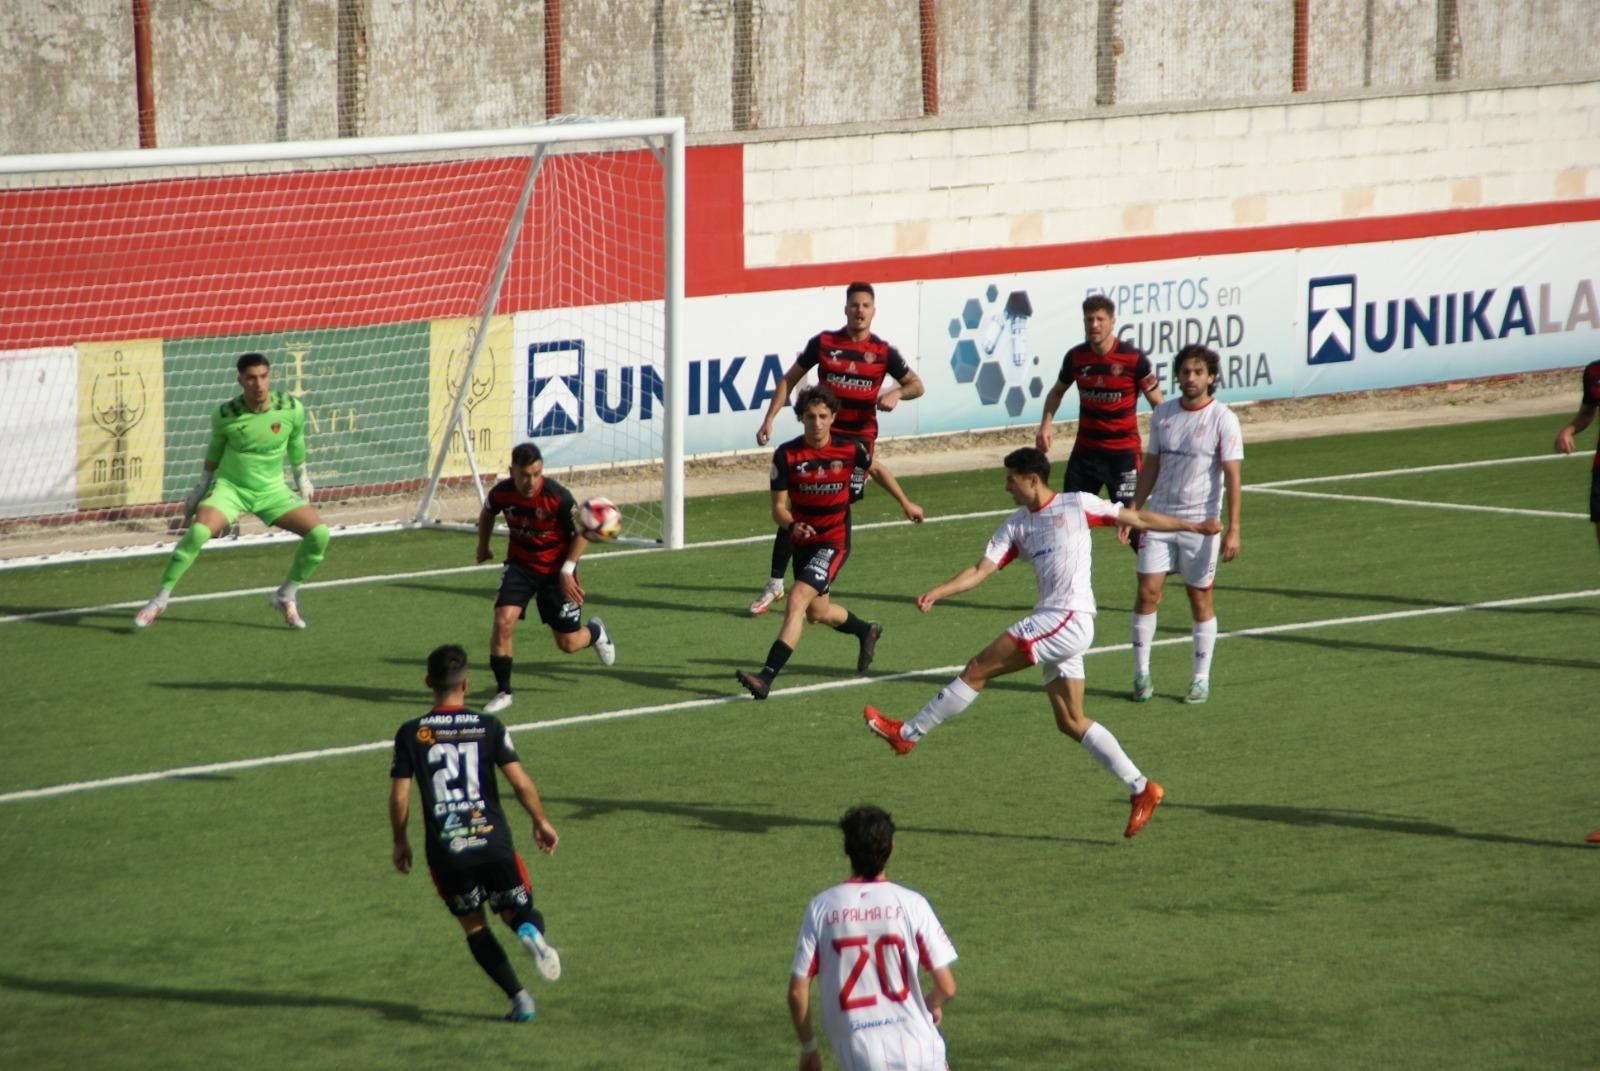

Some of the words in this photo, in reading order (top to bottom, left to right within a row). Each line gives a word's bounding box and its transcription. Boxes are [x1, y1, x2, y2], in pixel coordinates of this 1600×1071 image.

[1217, 286, 1241, 306] en
[1117, 313, 1245, 357] GURIDAD
[419, 715, 453, 726] MARIO
[455, 714, 480, 724] RUIZ
[427, 741, 481, 802] 21
[826, 910, 839, 925] LA
[842, 906, 882, 922] PALMA
[832, 933, 910, 1011] 20
